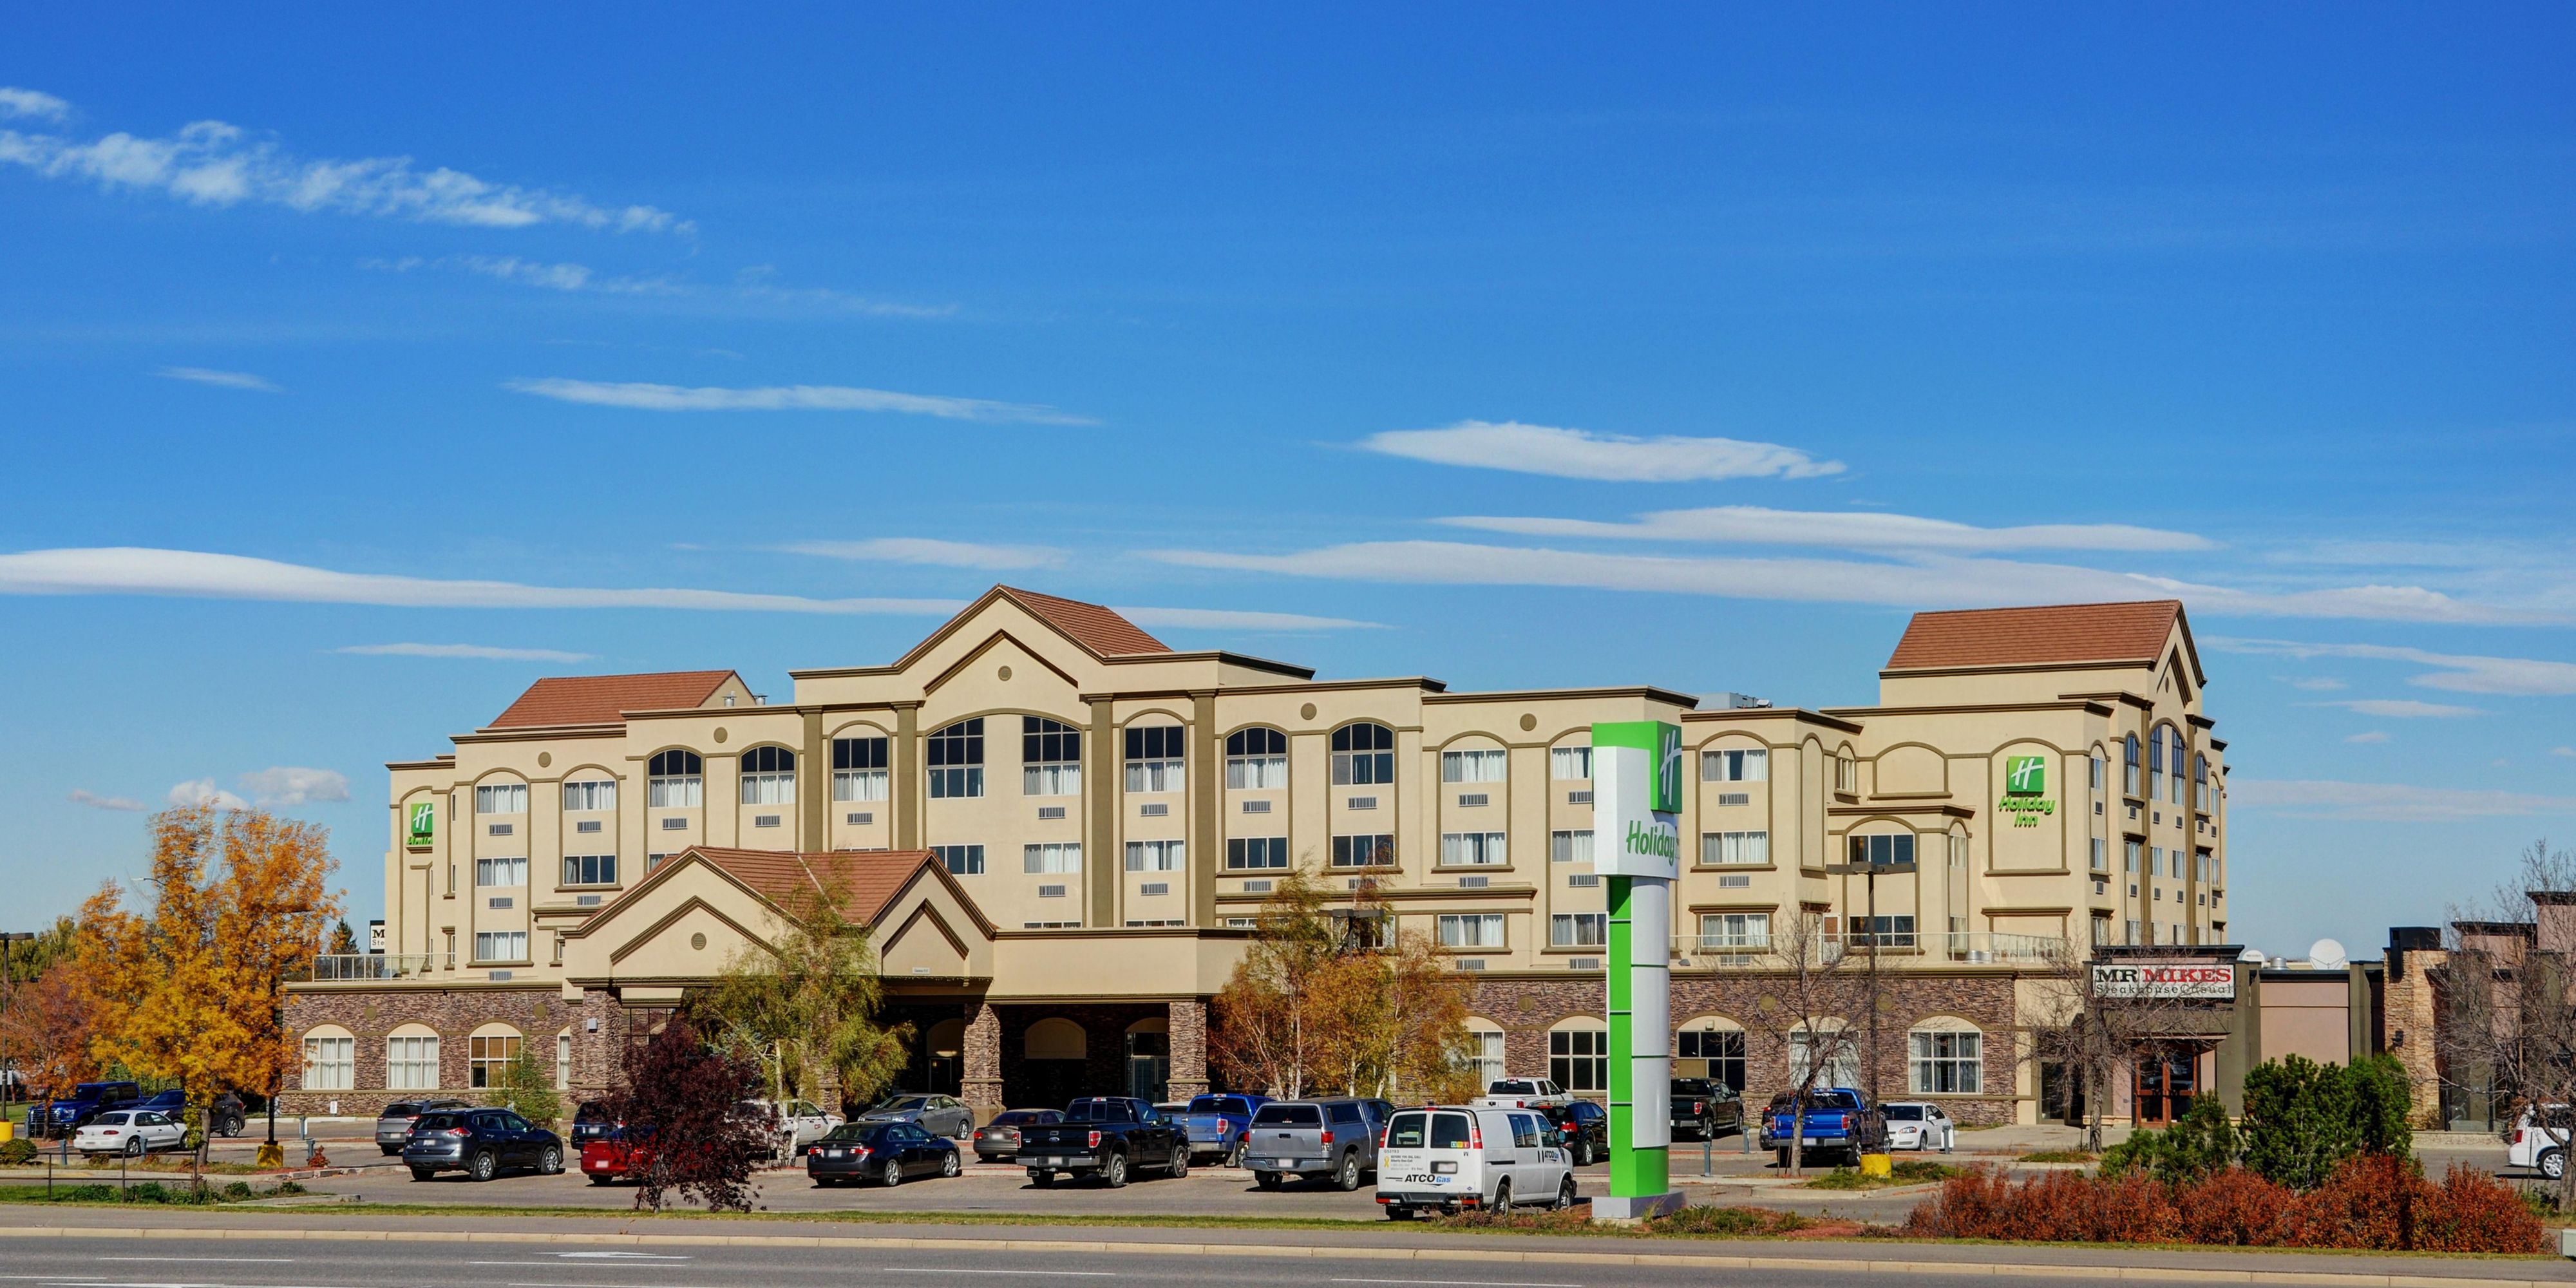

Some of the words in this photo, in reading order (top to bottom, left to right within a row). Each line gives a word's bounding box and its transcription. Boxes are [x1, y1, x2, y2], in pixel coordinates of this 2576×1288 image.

[1998, 795, 2056, 815] Holiday
[2014, 811, 2038, 826] Inn
[1626, 820, 1676, 866] Holiday
[2096, 969, 2137, 982] MR
[2143, 969, 2231, 983] MIKES
[1405, 1174, 1435, 1182] ATCO
